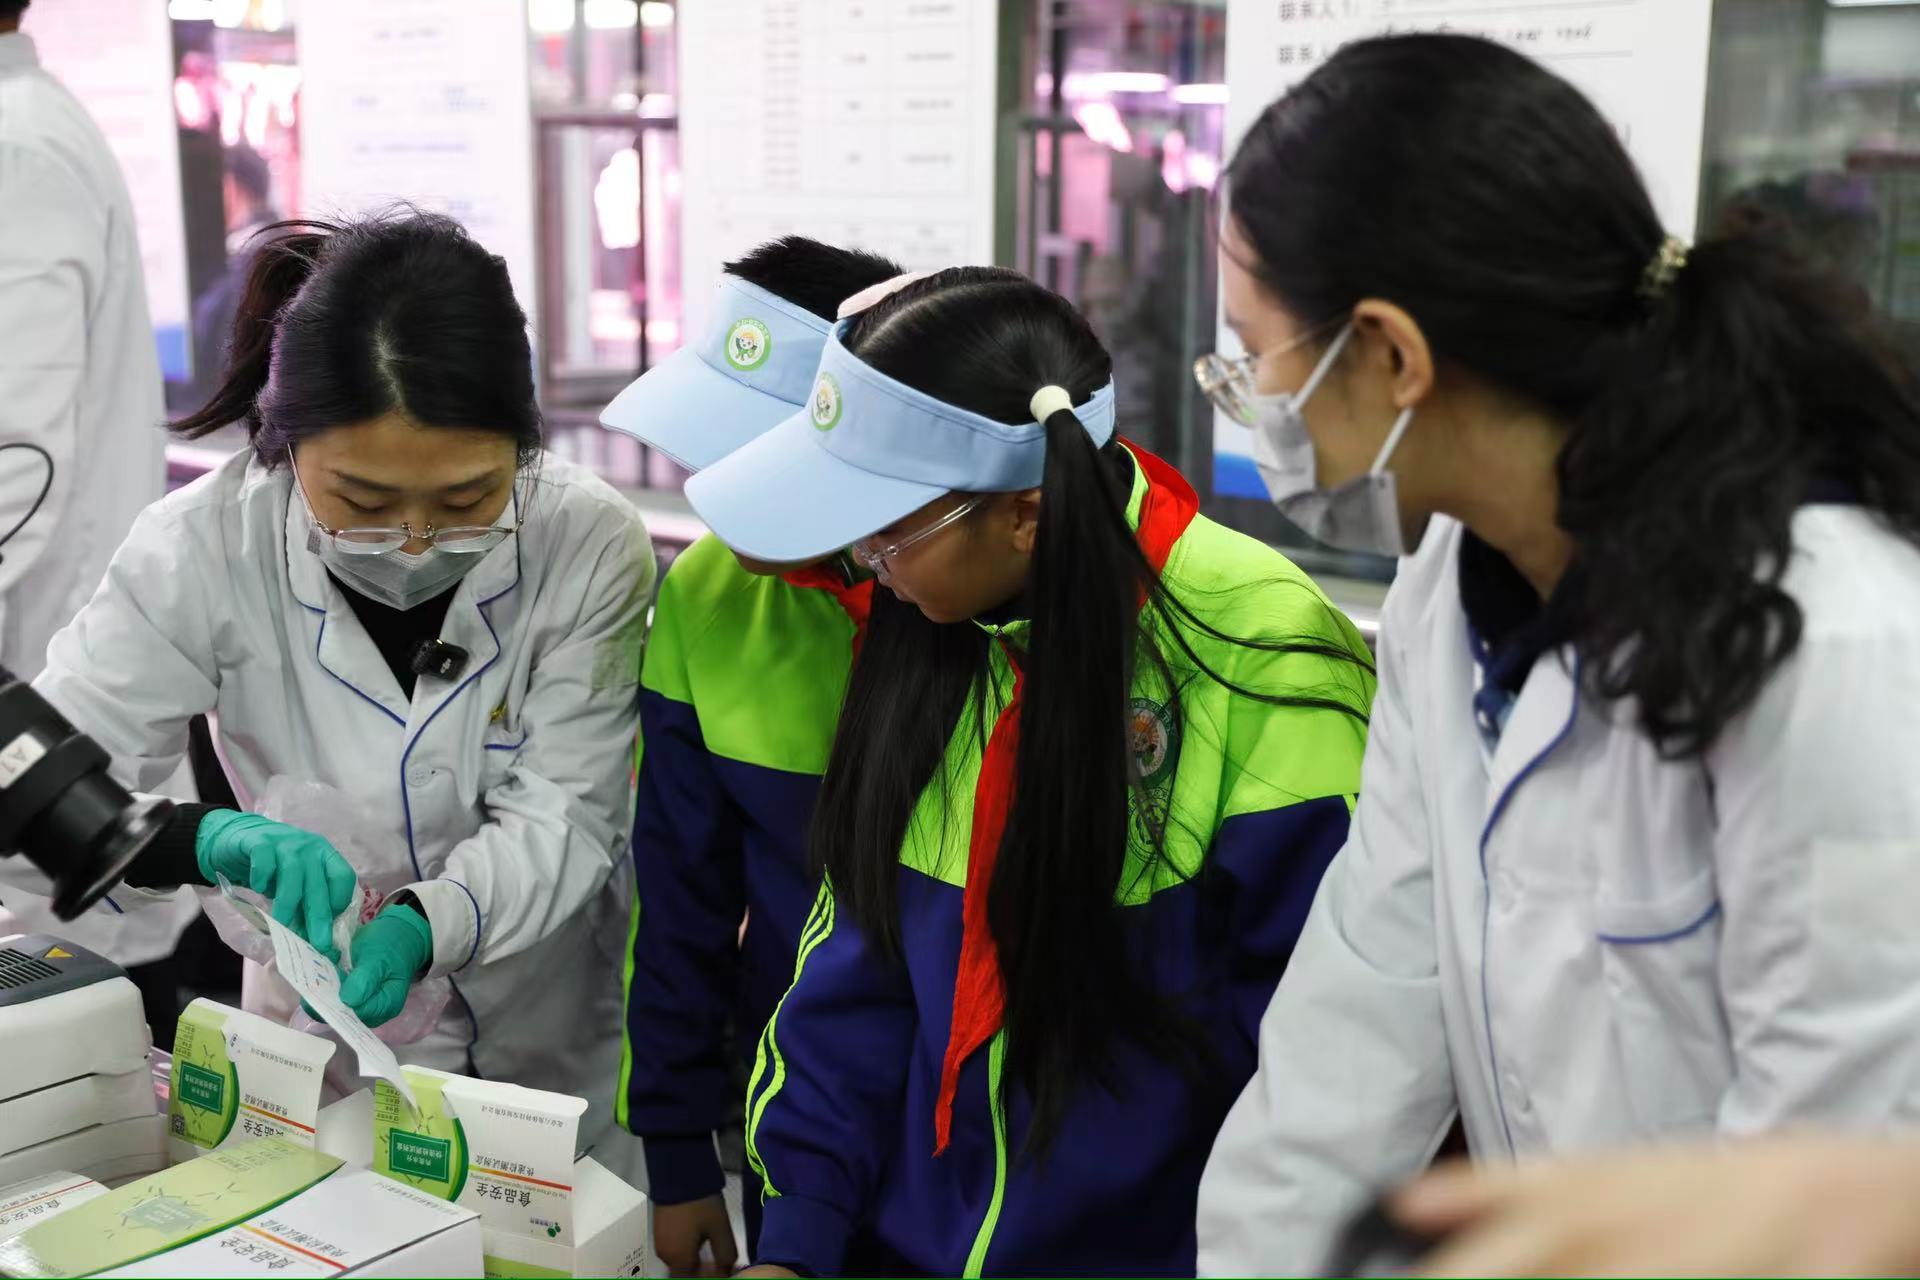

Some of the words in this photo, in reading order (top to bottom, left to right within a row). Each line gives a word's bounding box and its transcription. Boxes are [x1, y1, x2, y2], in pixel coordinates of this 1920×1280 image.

[475, 1154, 535, 1177] 快速检测试剂盒
[475, 1181, 532, 1208] 食品安全
[220, 1237, 296, 1270] 食品安全
